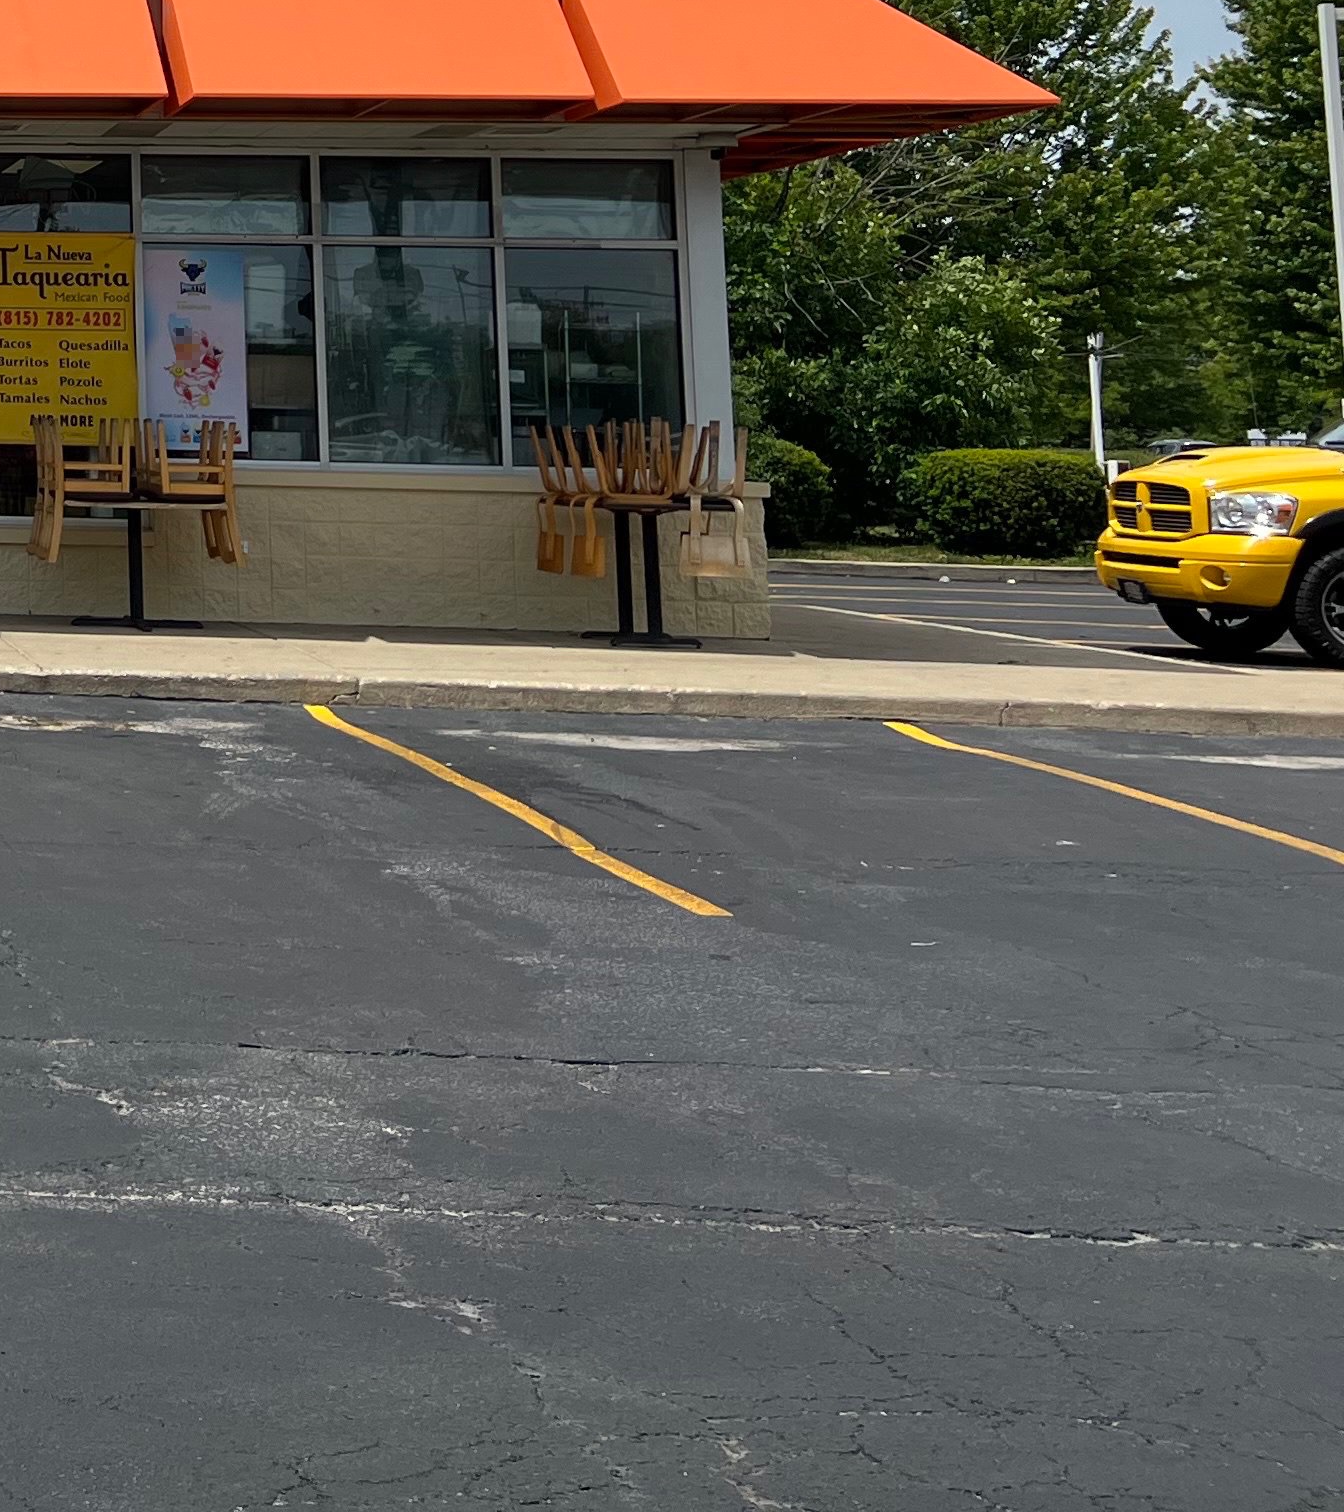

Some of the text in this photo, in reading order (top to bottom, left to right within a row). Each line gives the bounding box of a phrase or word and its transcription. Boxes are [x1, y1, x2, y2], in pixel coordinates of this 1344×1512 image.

[24, 244, 92, 261] La Nueva
[54, 291, 130, 303] Mexican Food
[46, 311, 121, 327] 782-4202
[58, 339, 129, 352] Quesadilla
[59, 357, 91, 369] Elote
[59, 376, 103, 387] Pozole
[59, 394, 108, 406] Nachos
[60, 415, 94, 427] MORE
